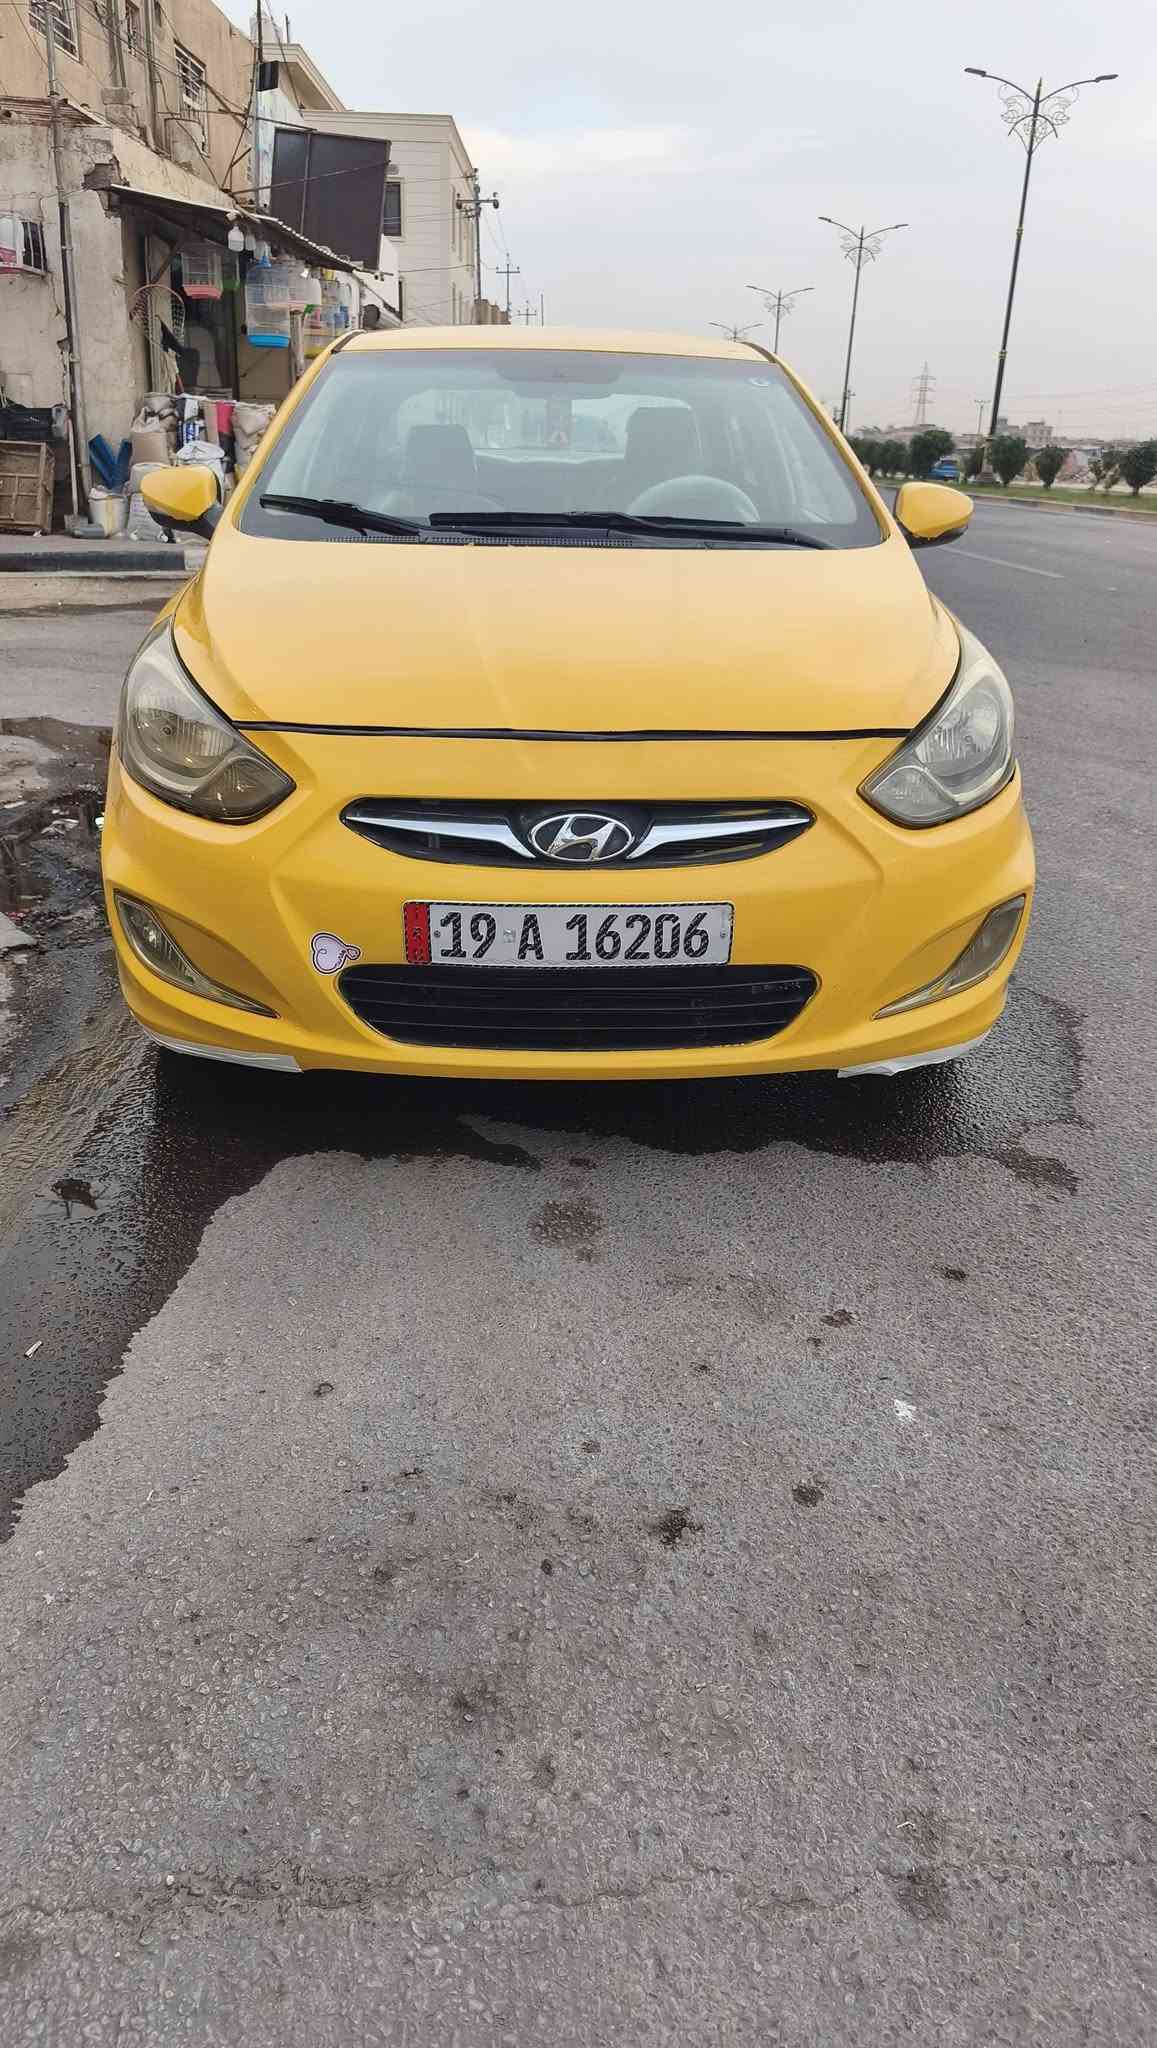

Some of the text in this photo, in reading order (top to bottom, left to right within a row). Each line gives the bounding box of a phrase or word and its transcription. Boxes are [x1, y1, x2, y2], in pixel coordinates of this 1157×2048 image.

[440, 912, 709, 960] 19 A 16206
